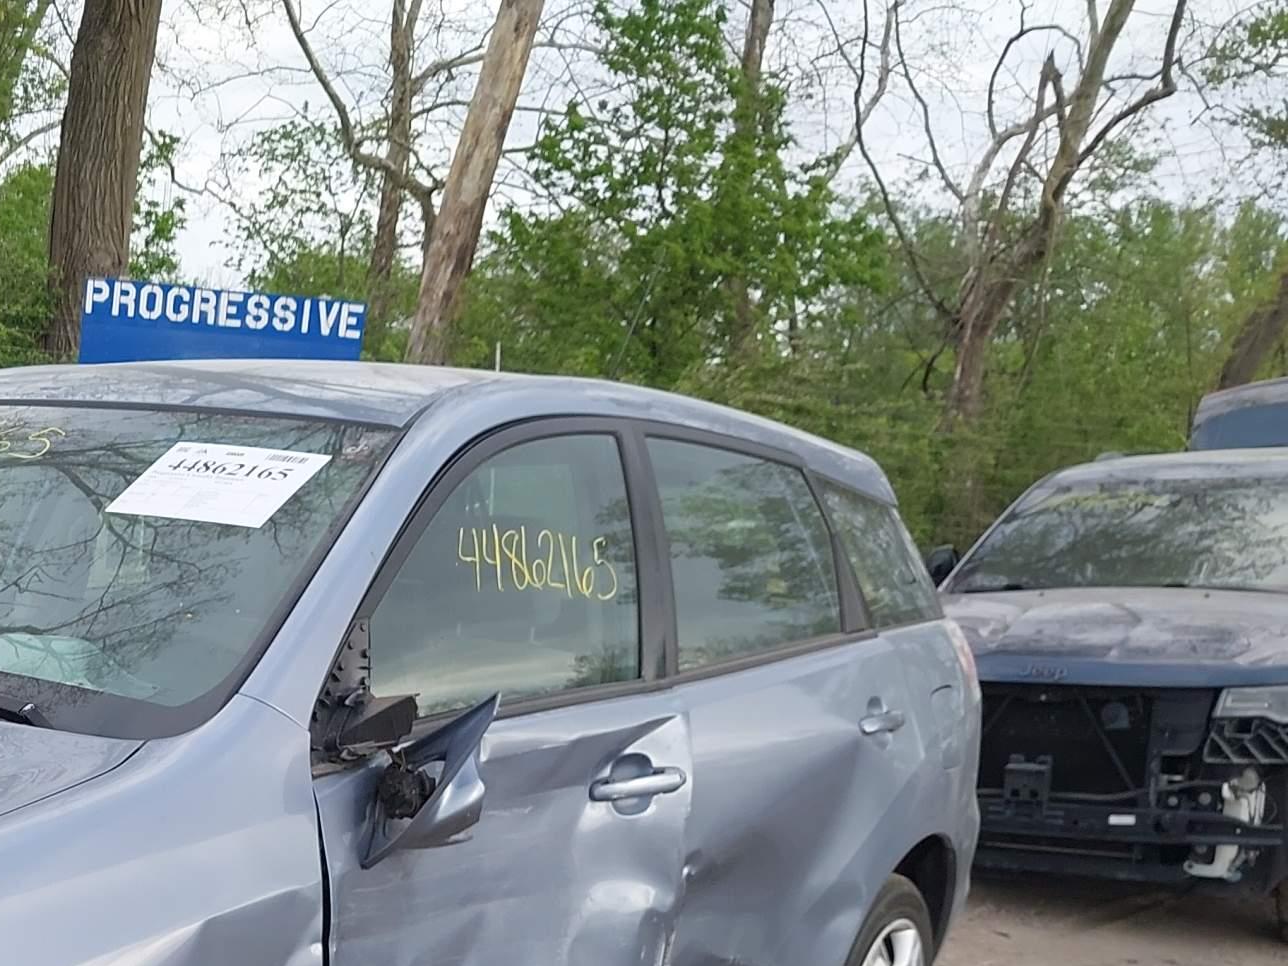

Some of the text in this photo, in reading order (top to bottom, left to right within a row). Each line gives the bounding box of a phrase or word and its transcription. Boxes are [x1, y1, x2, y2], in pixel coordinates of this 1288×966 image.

[84, 279, 366, 340] PROGRESSIVE
[167, 458, 295, 481] 44862165
[458, 523, 618, 600] 44862165
